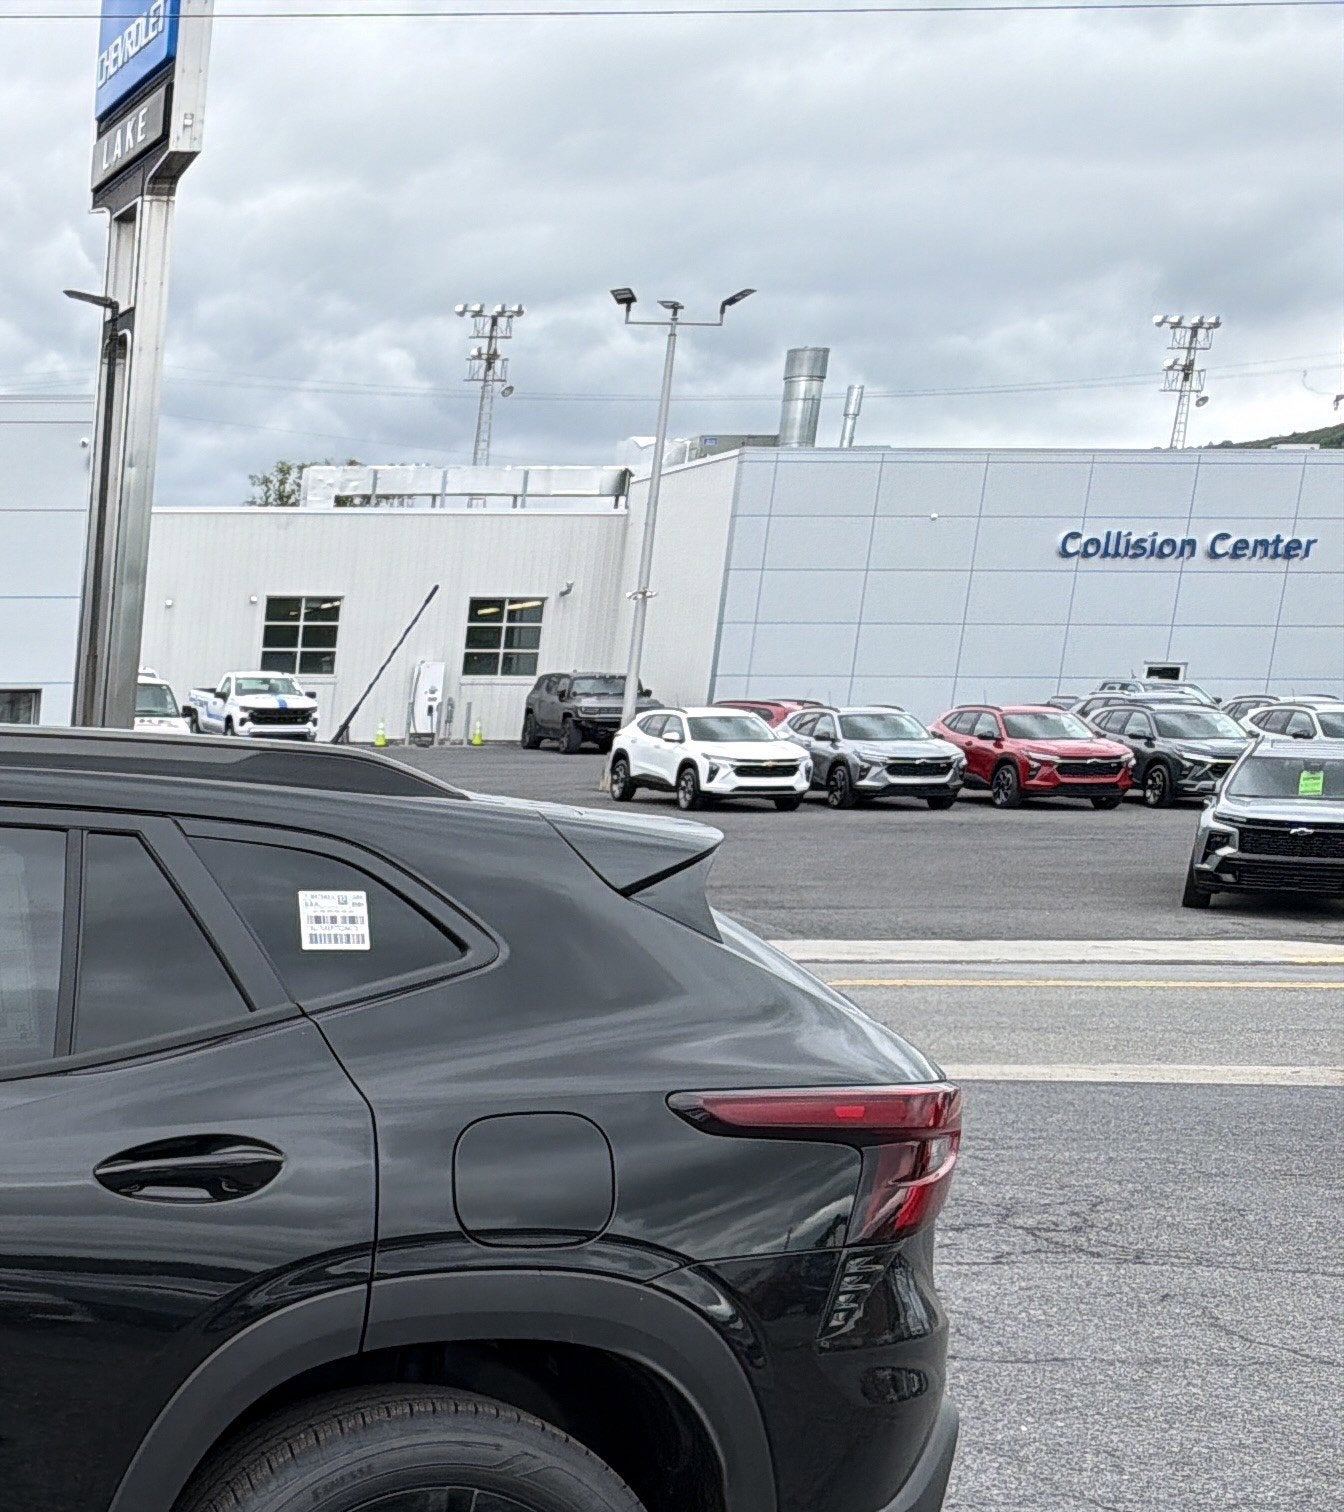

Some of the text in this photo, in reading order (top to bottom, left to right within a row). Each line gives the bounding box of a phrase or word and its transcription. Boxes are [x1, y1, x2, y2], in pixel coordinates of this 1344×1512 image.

[97, 0, 164, 88] CHEVROLET
[103, 107, 148, 170] LAKE
[1061, 531, 1318, 560] Collision Center
